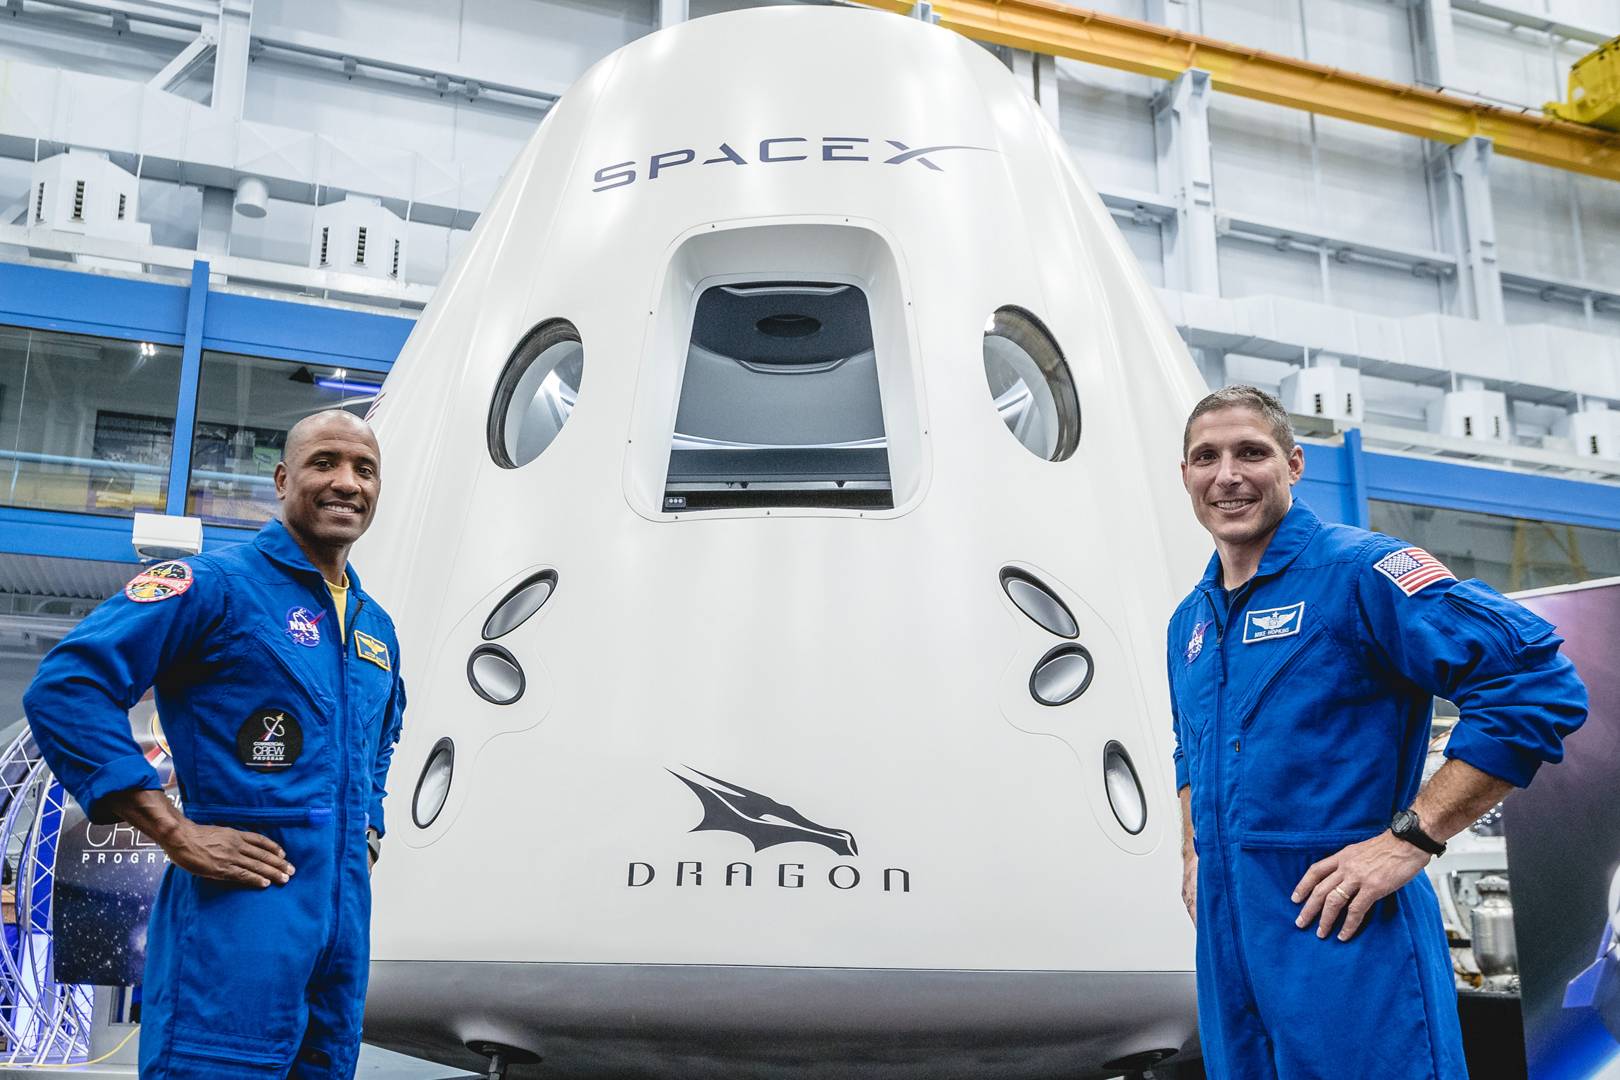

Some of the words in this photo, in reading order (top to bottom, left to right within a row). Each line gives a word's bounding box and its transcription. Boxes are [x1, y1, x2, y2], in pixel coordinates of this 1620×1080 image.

[592, 137, 1001, 193] SPACEX
[288, 620, 320, 635] NASA
[1254, 630, 1266, 639] MIKE
[1267, 627, 1290, 636] HOPKINS
[252, 746, 285, 756] CREW
[81, 853, 171, 864] PROGRA
[627, 861, 910, 893] DRAGON
